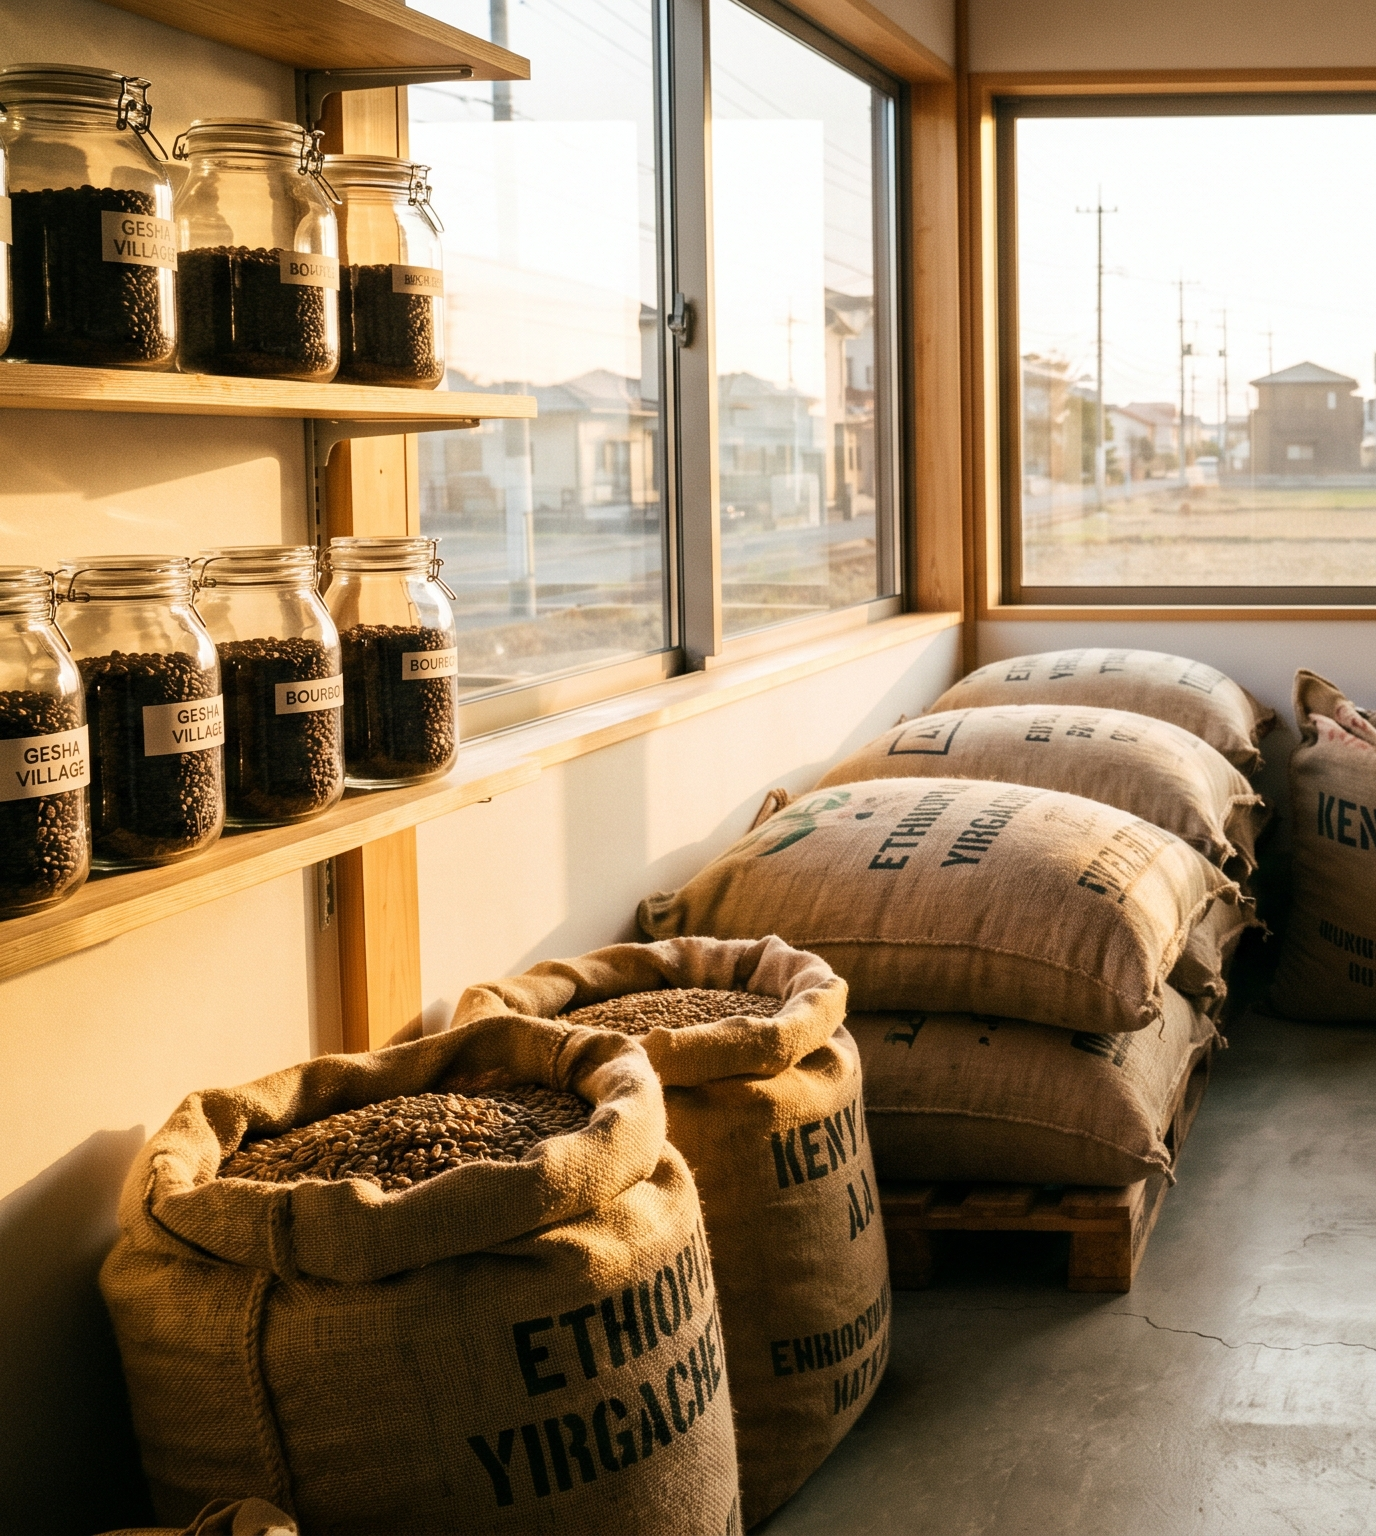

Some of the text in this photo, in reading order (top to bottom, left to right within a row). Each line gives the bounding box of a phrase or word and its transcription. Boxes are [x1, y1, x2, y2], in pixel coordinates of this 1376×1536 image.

[121, 219, 171, 242] GESHA
[177, 703, 220, 724] GESHA
[172, 720, 223, 744] VILLAGE
[23, 740, 80, 765] GESHA
[15, 759, 85, 787] VILLAGE
[846, 1168, 875, 1242] AA
[466, 1297, 726, 1508] YIRGACHE
